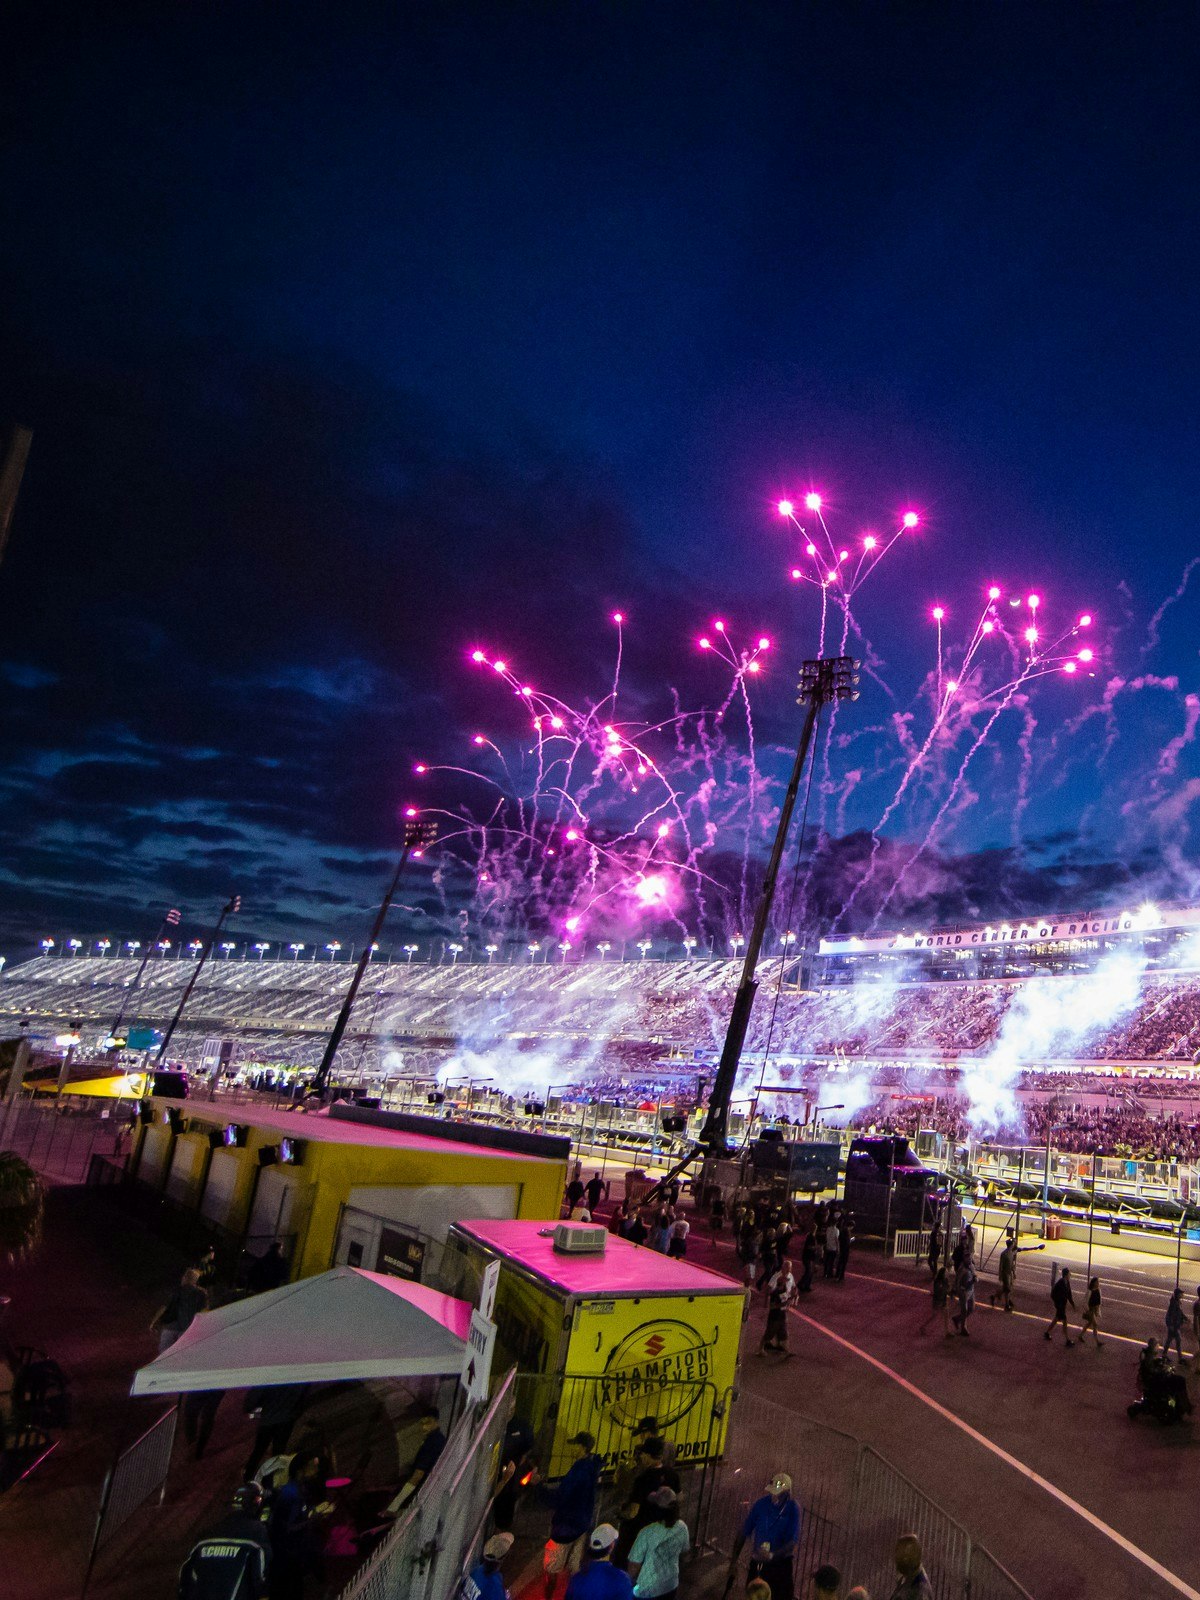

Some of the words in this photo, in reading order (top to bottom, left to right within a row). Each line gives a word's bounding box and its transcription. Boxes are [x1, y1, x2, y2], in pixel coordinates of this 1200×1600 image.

[915, 935, 962, 947] WORLD
[971, 929, 1028, 943] CENTER
[1040, 926, 1058, 937] OF
[1068, 920, 1131, 935] RACING
[602, 1348, 708, 1391] CHAMPION
[675, 1440, 708, 1458] PORT
